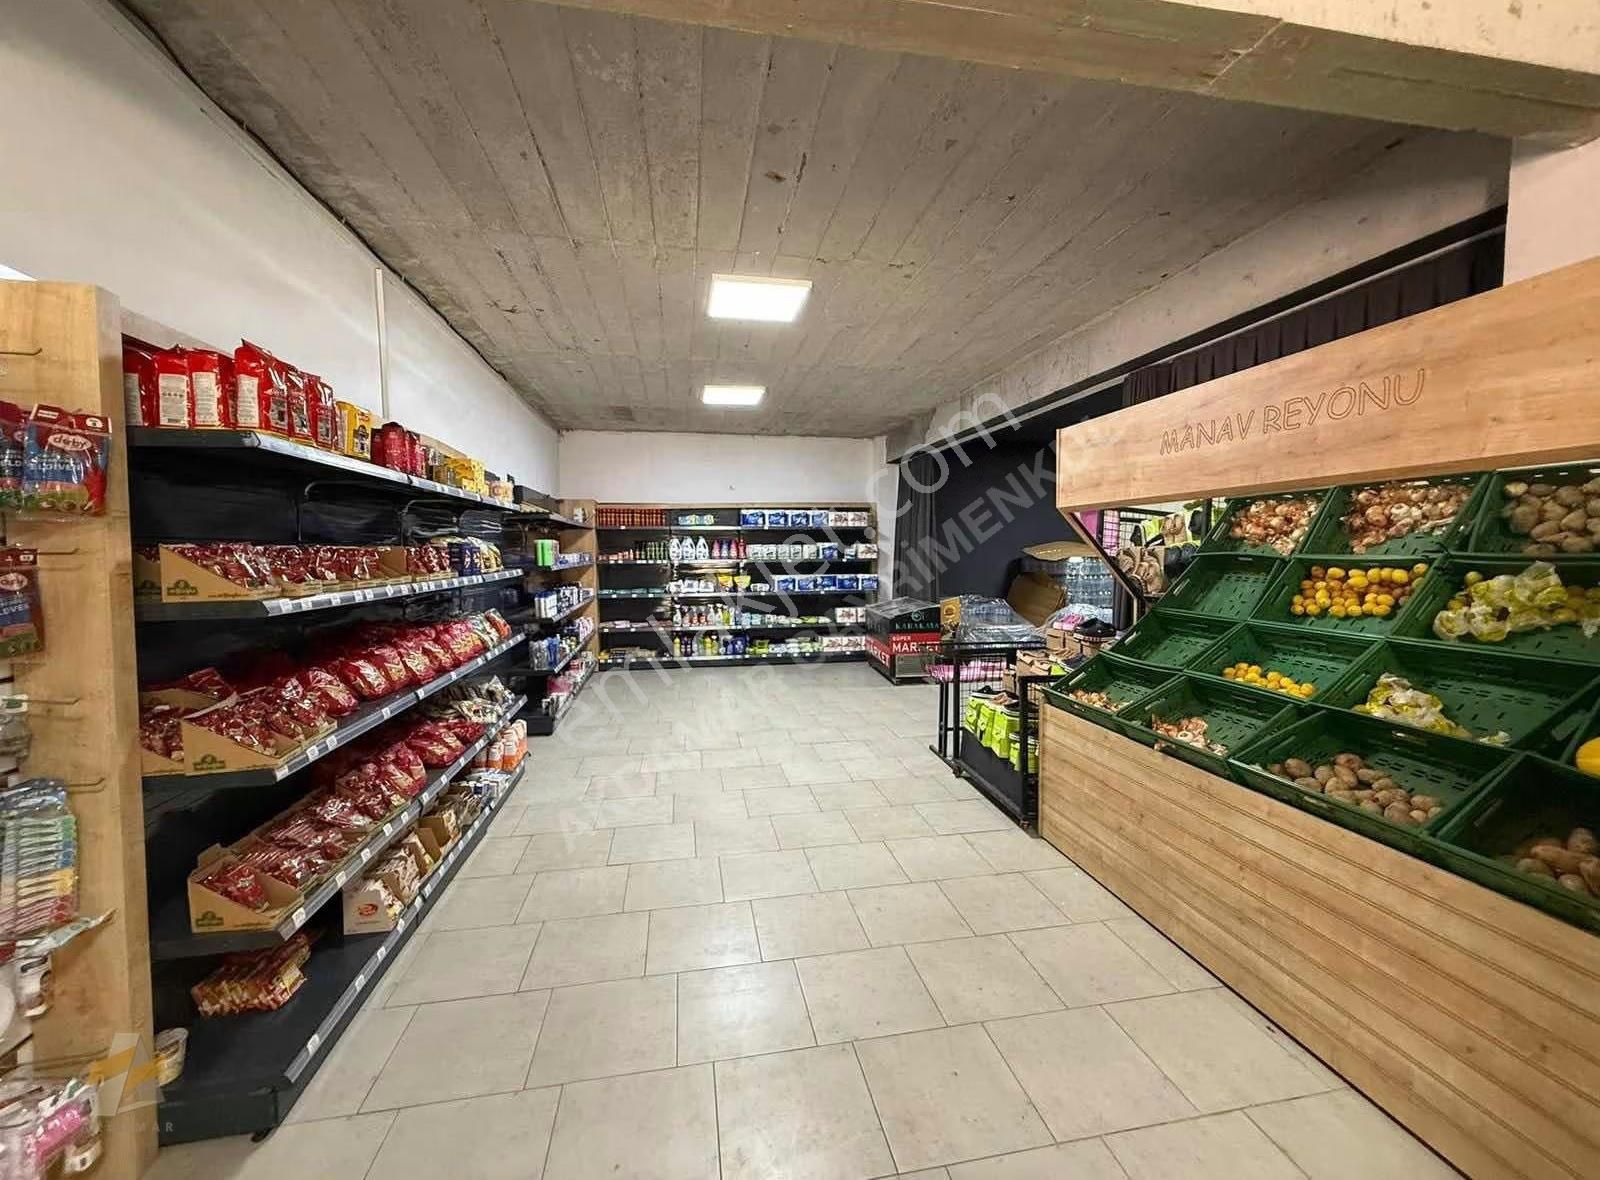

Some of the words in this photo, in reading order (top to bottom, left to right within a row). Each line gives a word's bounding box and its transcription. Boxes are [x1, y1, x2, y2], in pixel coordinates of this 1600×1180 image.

[1159, 408, 1255, 456] MANAV
[1263, 368, 1425, 435] REYONU
[53, 435, 87, 448] derby
